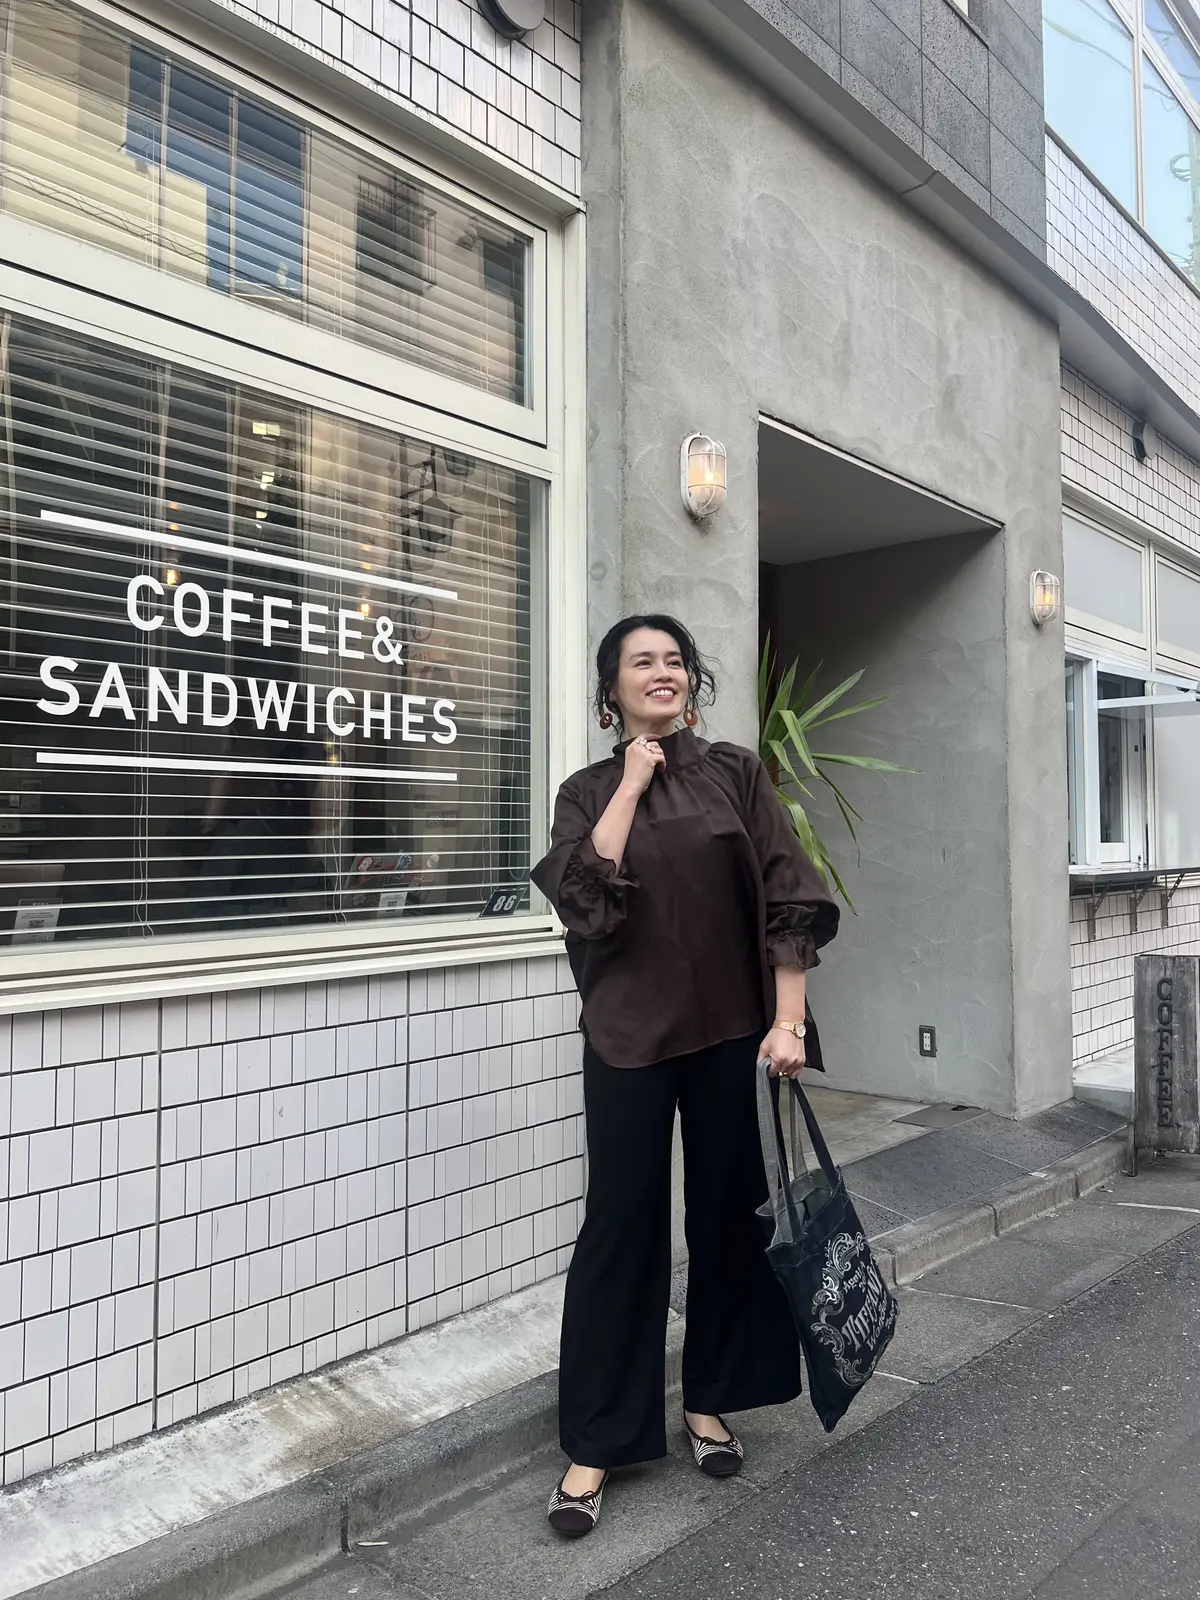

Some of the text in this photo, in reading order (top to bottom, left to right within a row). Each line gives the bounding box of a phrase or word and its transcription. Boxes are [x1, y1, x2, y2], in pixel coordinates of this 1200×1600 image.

[36, 656, 458, 745] SANDWICHES
[492, 894, 518, 912] 86
[1156, 977, 1174, 1128] COFFEE
